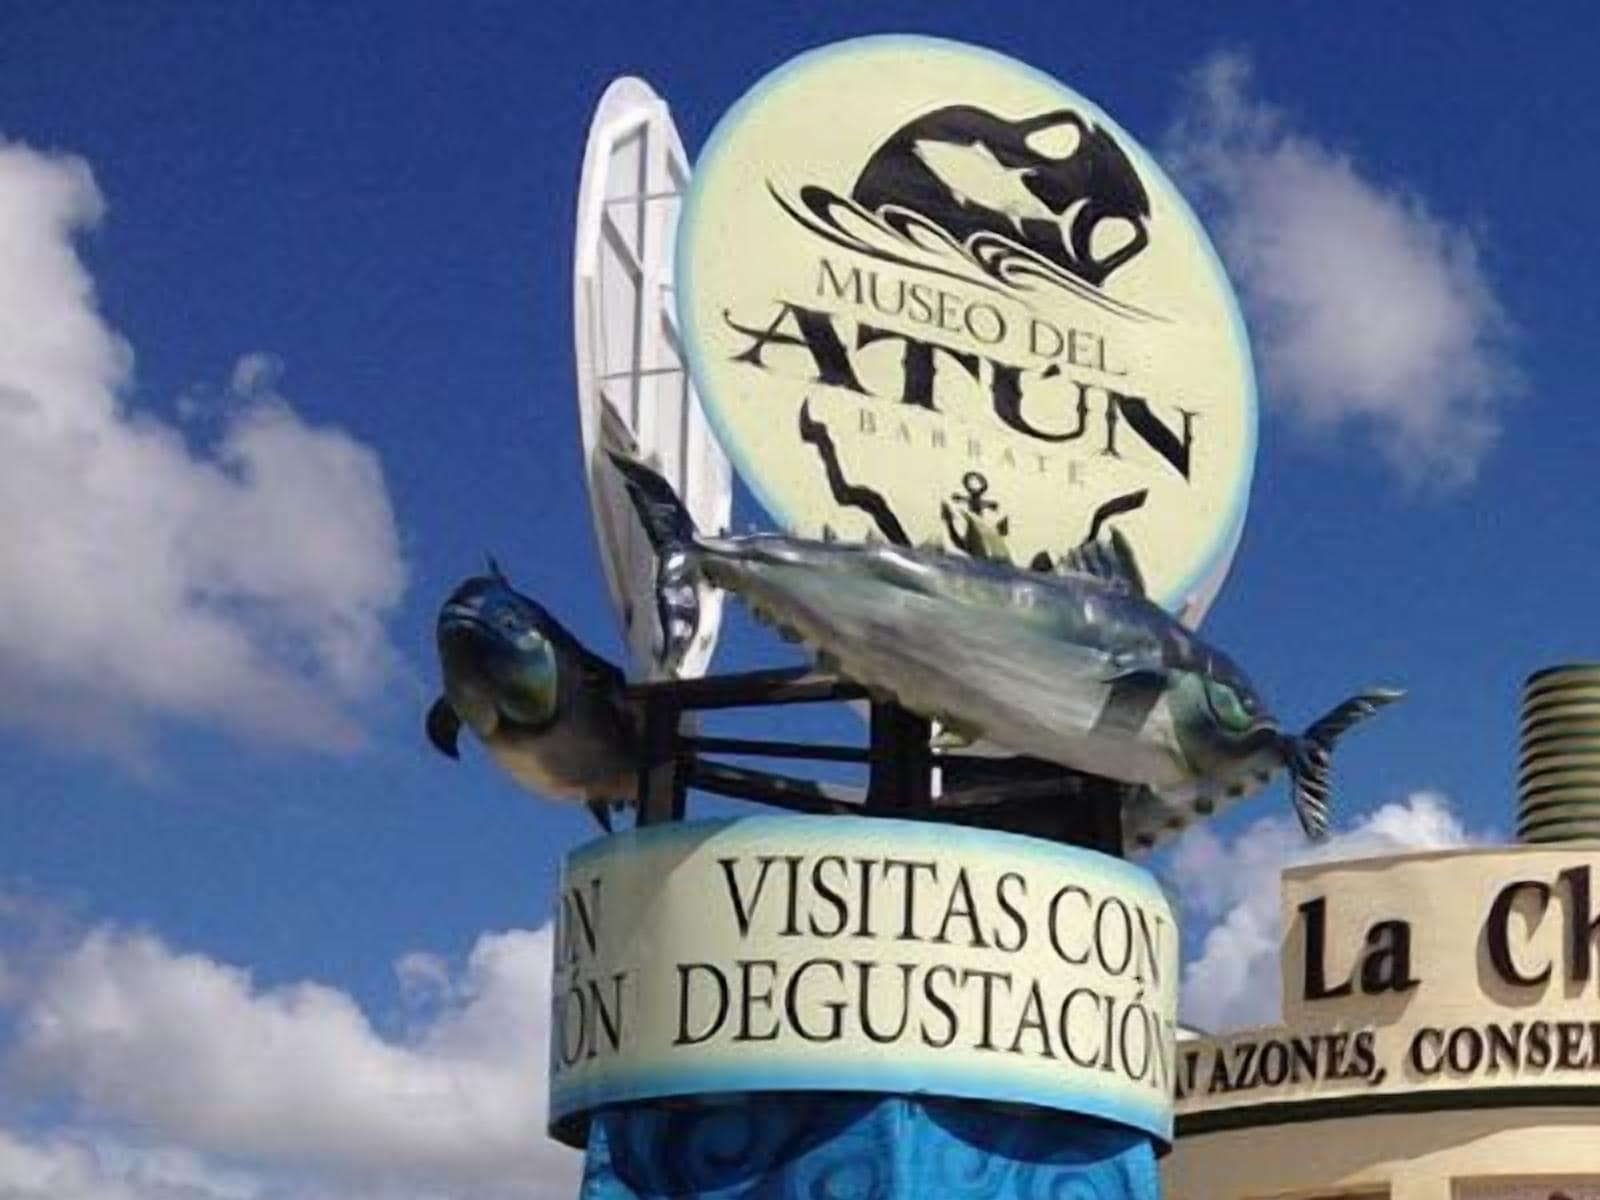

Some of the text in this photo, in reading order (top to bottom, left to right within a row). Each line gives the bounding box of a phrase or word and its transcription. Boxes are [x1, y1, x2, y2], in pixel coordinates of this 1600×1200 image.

[816, 258, 1128, 377] MUSEO DEL
[722, 301, 1200, 482] ATÚN
[718, 855, 1166, 988] VISITAS CON
[1298, 893, 1421, 1002] La
[672, 958, 1173, 1092] DEGUSTACIÓN
